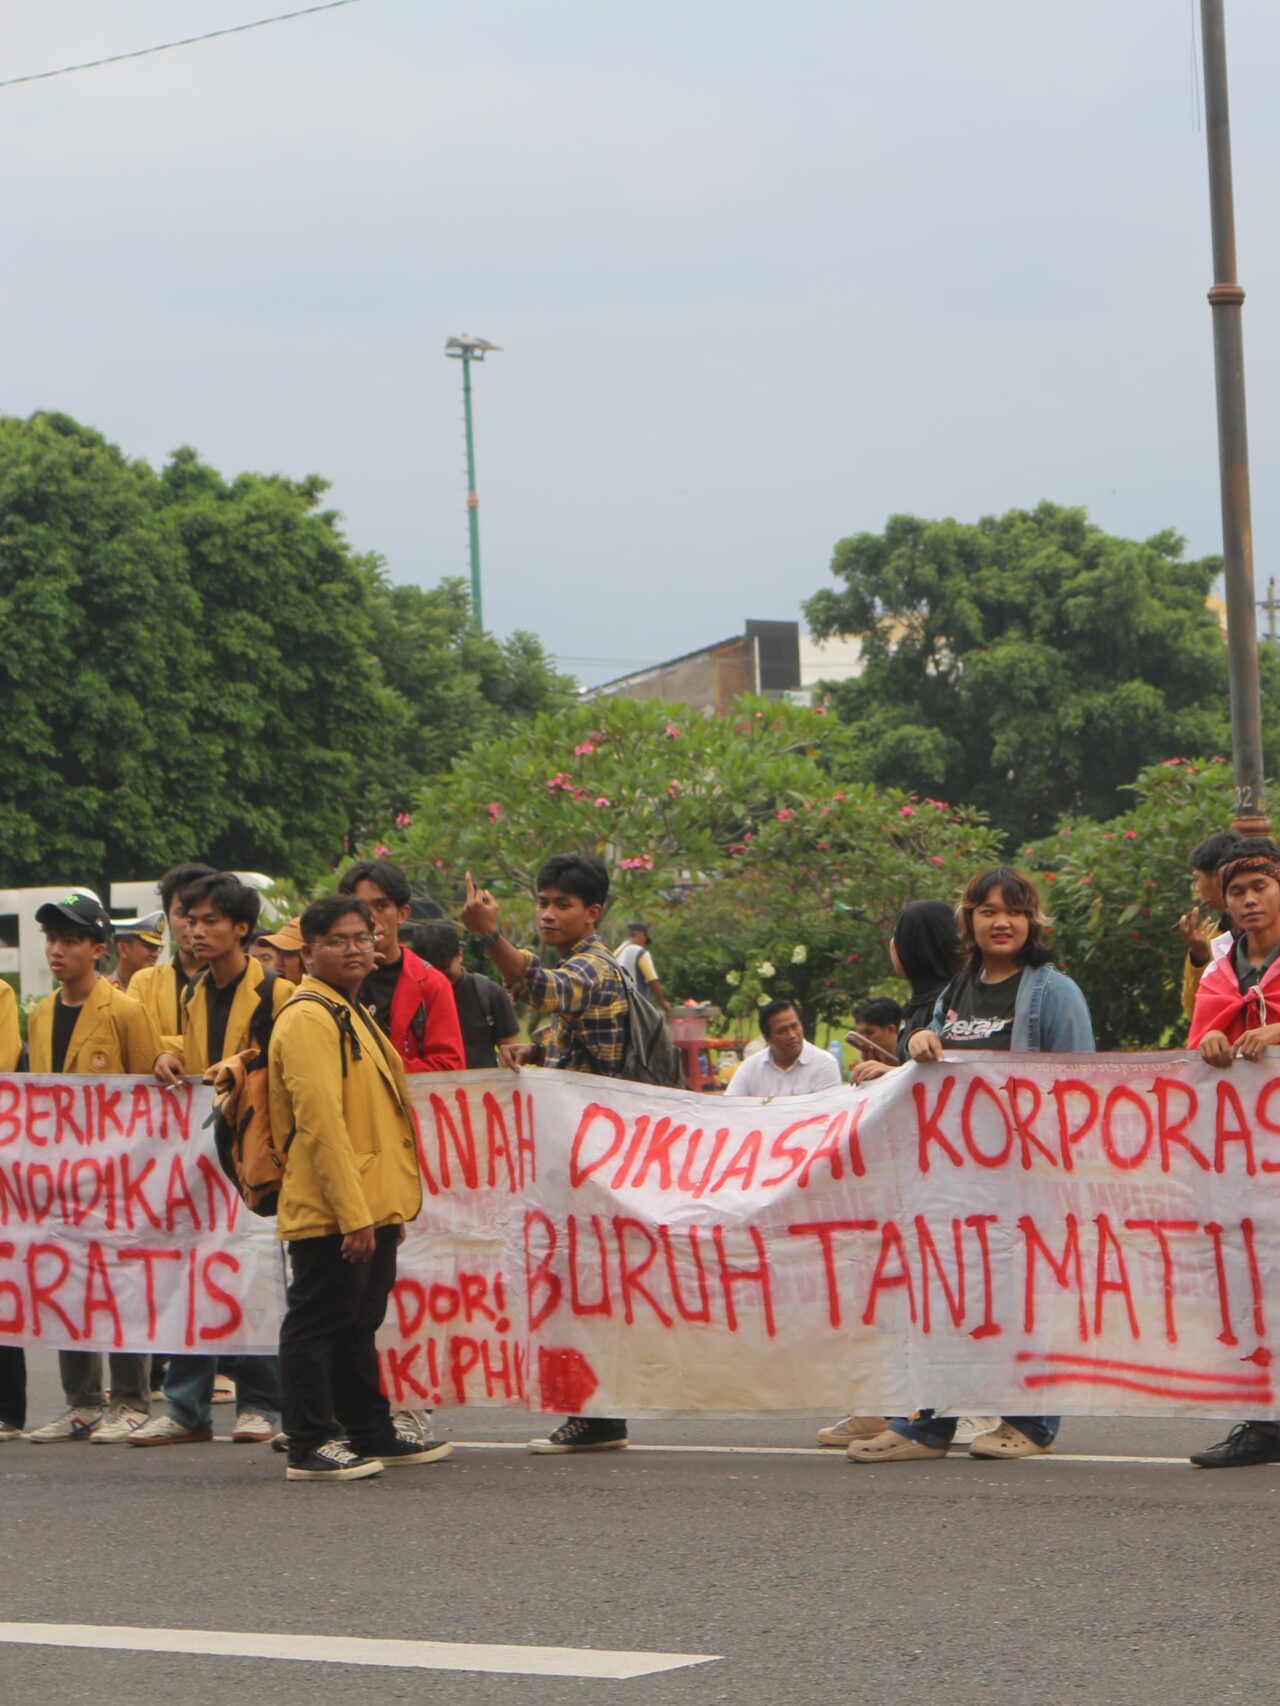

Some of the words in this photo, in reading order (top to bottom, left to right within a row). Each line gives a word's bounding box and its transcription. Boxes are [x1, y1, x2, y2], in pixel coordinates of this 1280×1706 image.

[569, 1100, 868, 1199] DIKUASAI
[523, 1209, 777, 1339] BURUH
[788, 1214, 1002, 1341] TANI
